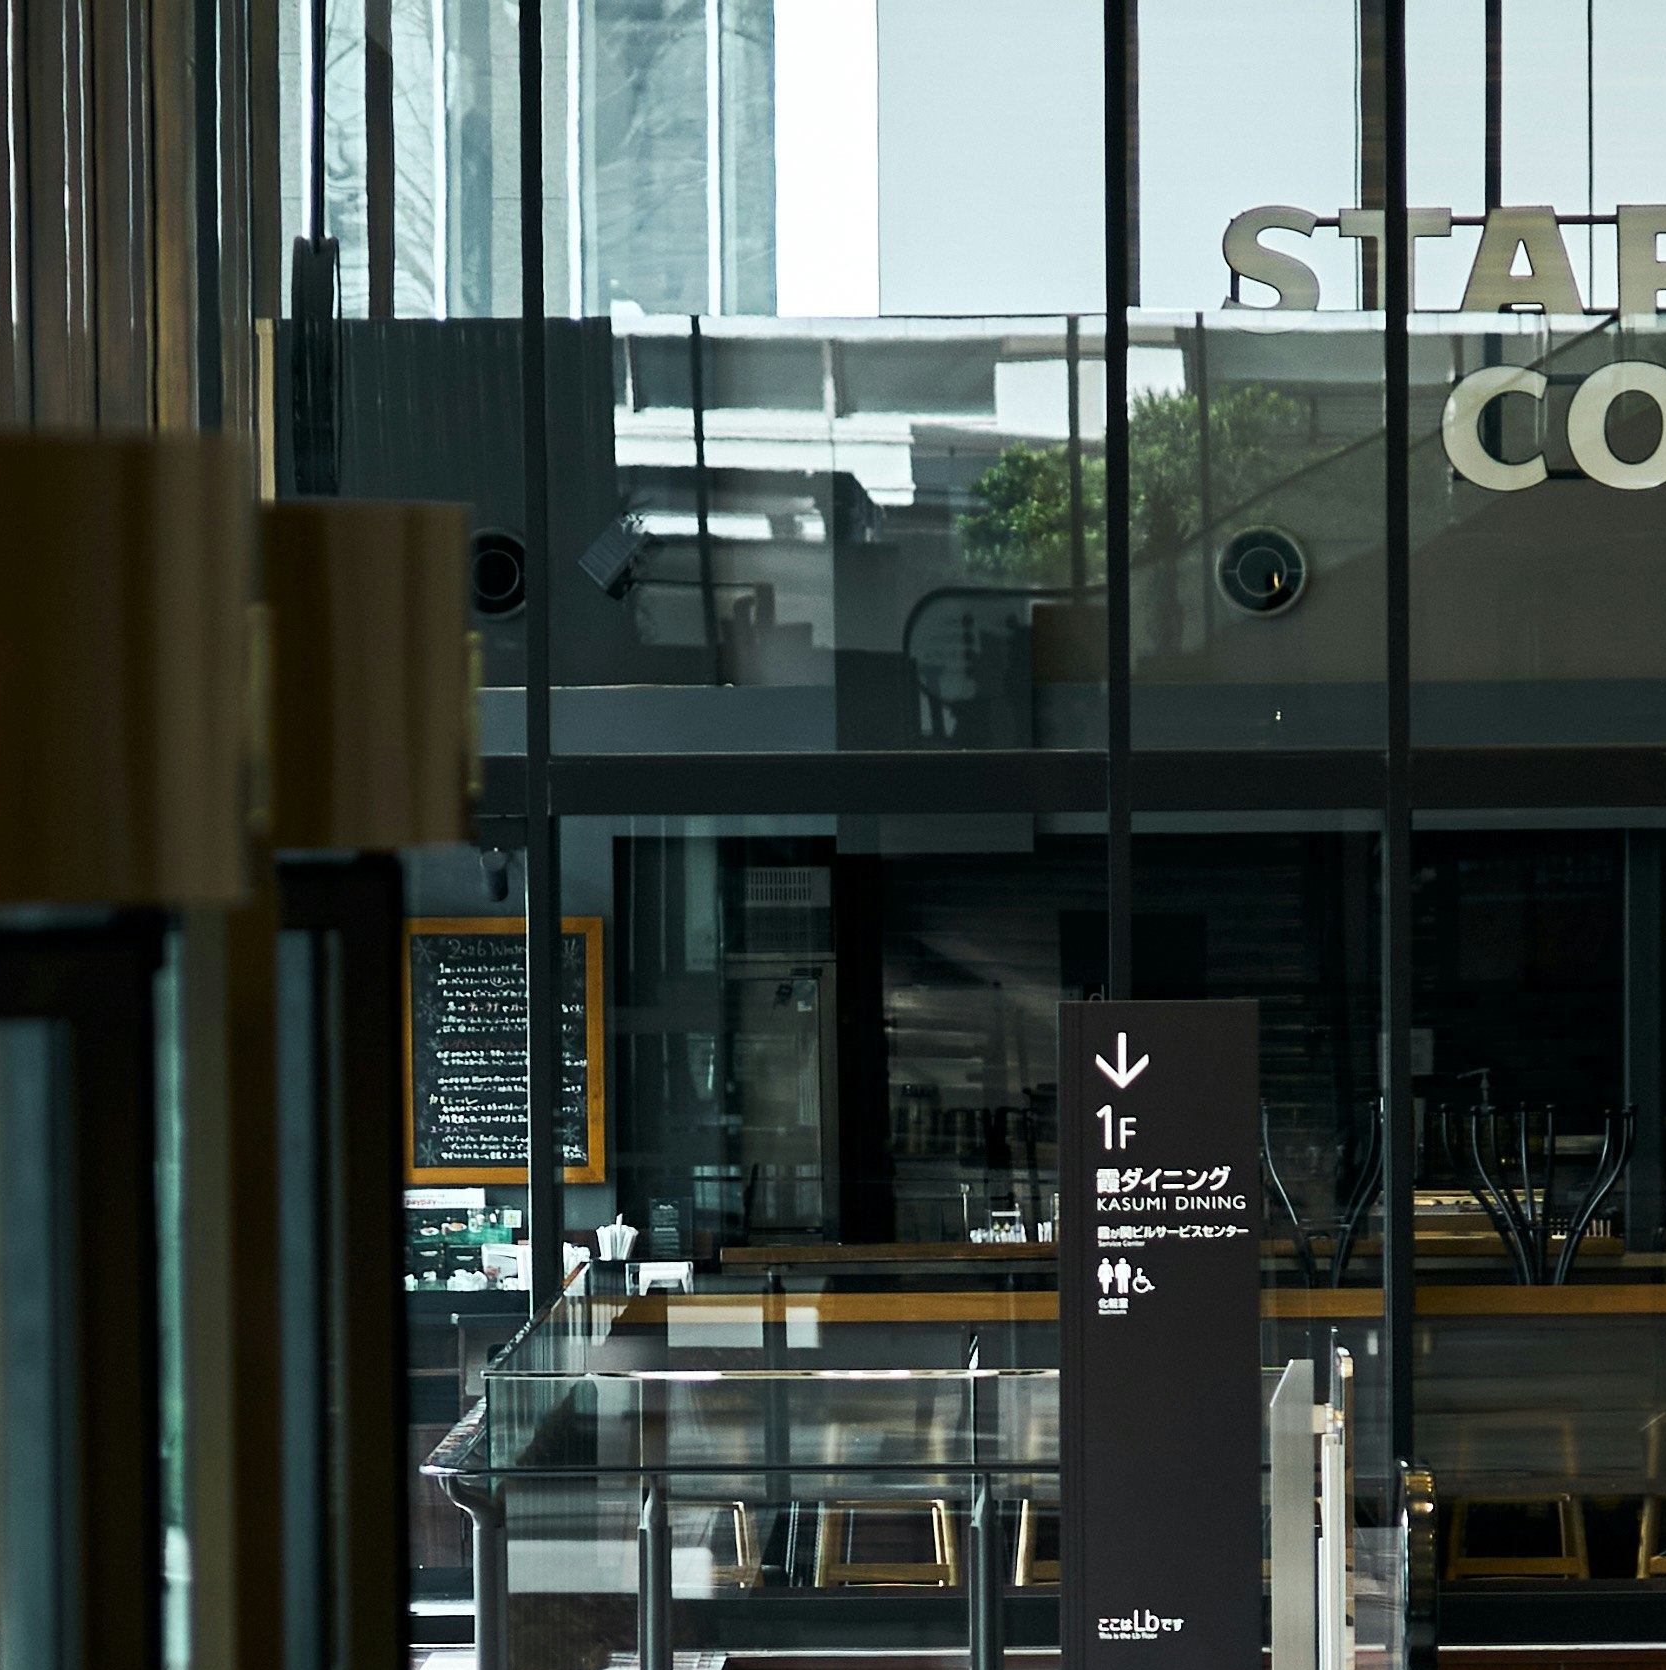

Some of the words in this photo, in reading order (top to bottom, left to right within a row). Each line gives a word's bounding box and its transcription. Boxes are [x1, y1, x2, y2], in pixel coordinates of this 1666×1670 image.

[1095, 1104, 1137, 1150] 1F
[1097, 1197, 1167, 1212] KASUMI
[1175, 1195, 1247, 1211] DINING
